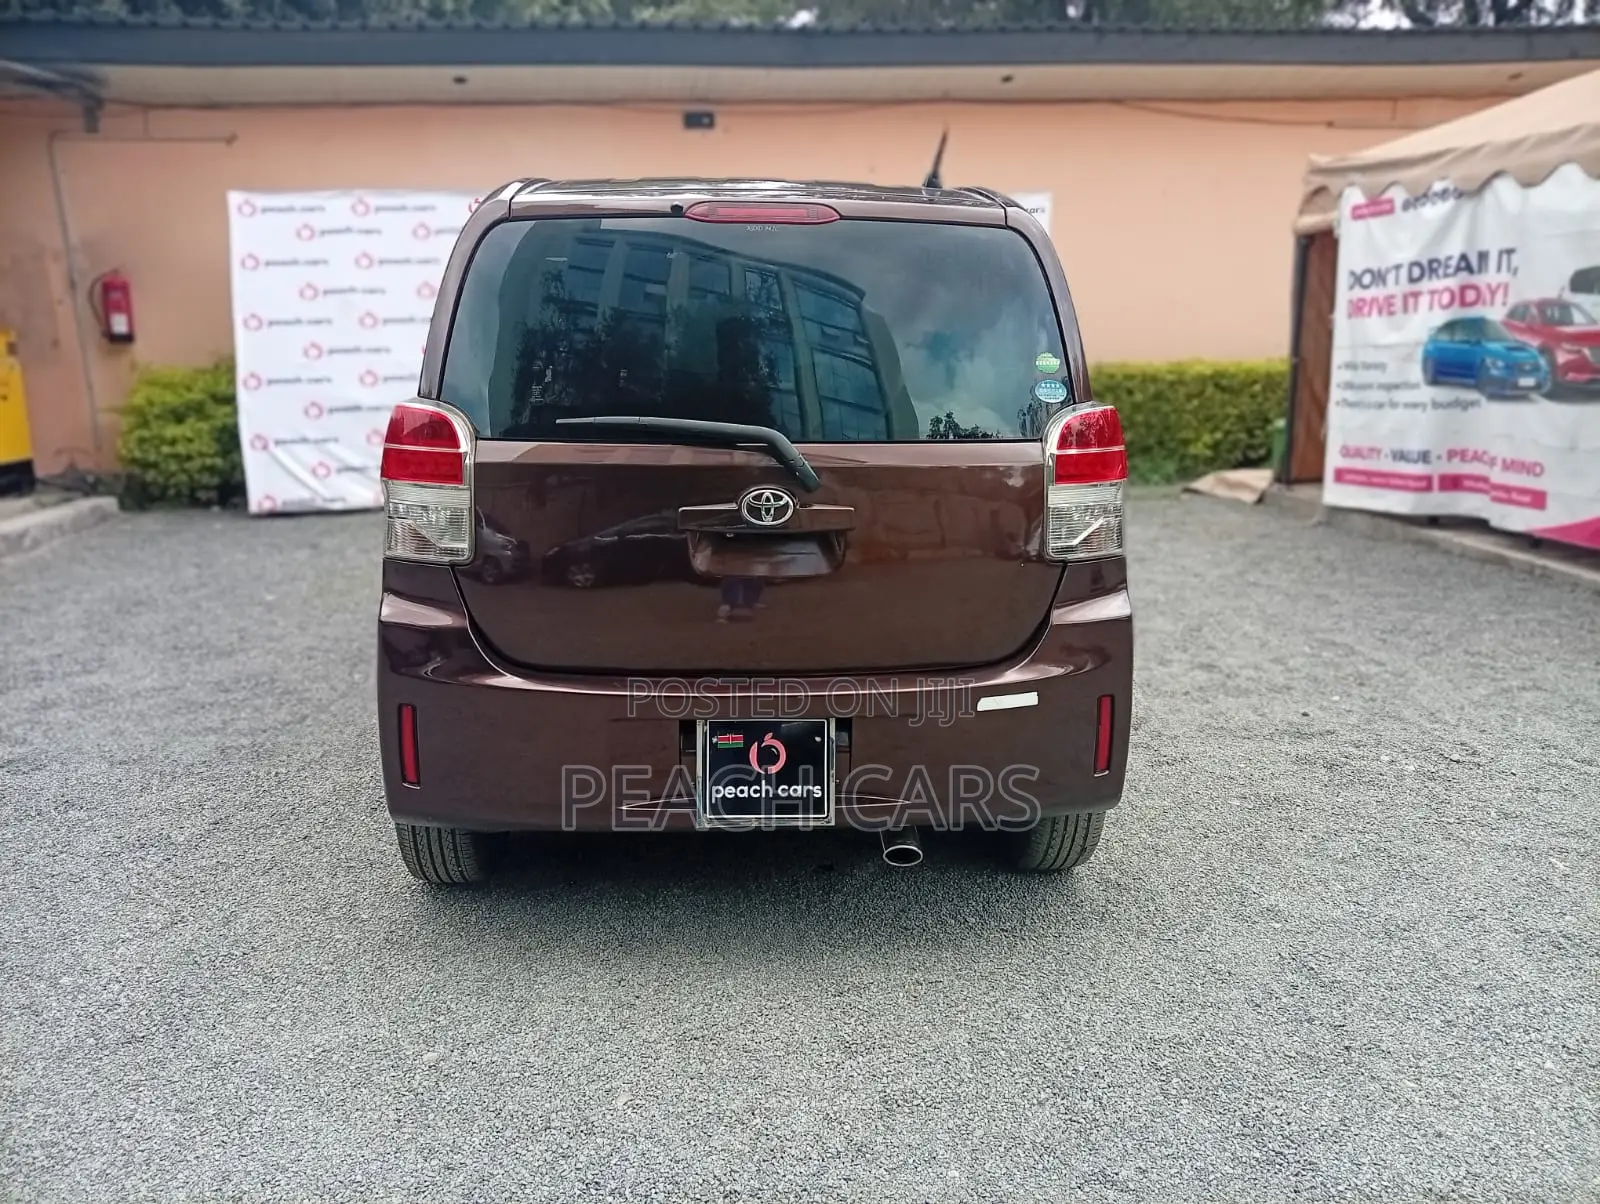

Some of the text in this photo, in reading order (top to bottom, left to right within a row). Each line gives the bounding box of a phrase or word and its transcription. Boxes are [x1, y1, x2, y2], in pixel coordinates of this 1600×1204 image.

[1402, 289, 1424, 315] IT
[1427, 280, 1510, 313] TODY!
[1502, 456, 1546, 478] MIND
[711, 779, 822, 804] peach cars
